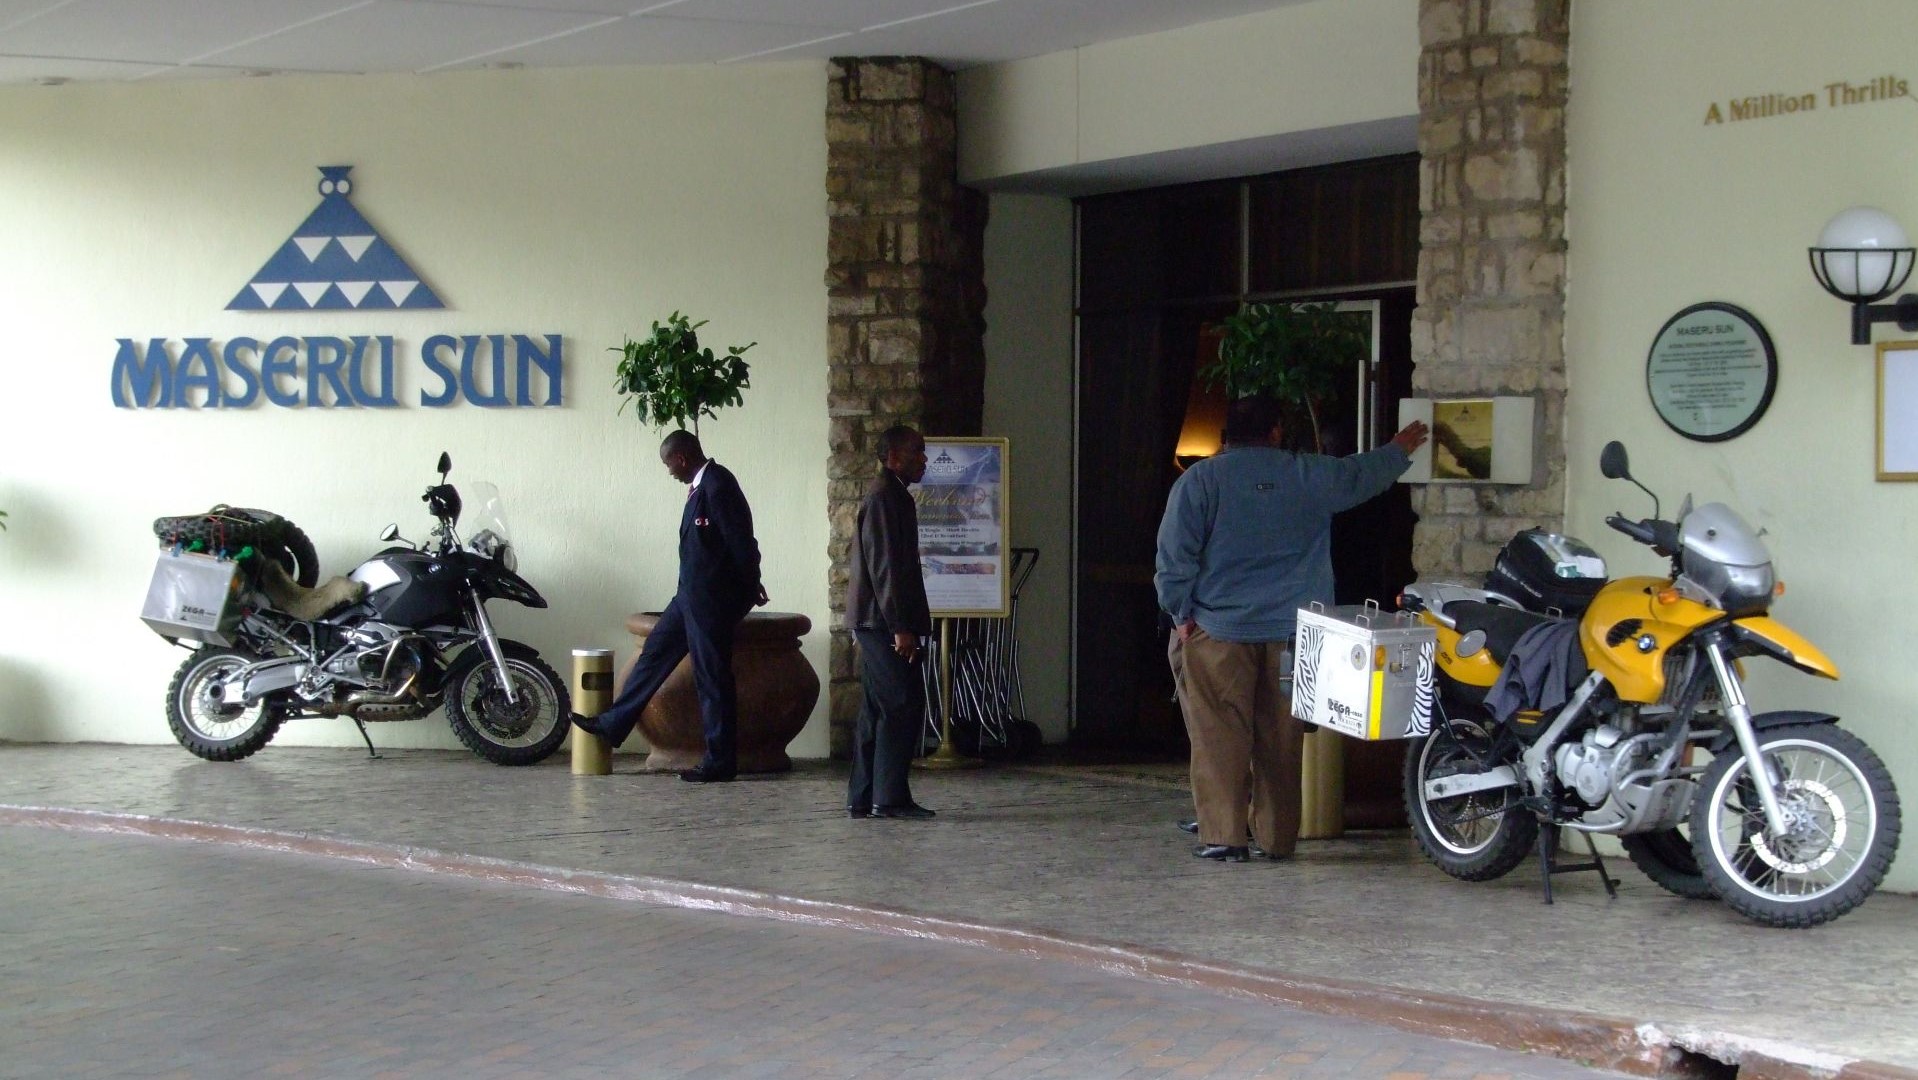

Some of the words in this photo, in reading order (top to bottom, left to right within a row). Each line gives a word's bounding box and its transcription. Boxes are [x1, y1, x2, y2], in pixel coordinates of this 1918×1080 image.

[1704, 102, 1724, 126] A
[1729, 92, 1817, 122] Million
[1824, 75, 1909, 107] Thrills
[1677, 326, 1713, 336] MASERU
[1715, 324, 1734, 334] SUN
[110, 336, 400, 408] MASERU
[420, 334, 563, 408] SUN
[182, 605, 205, 614] ZEGA
[1328, 698, 1351, 716] ZEGA
